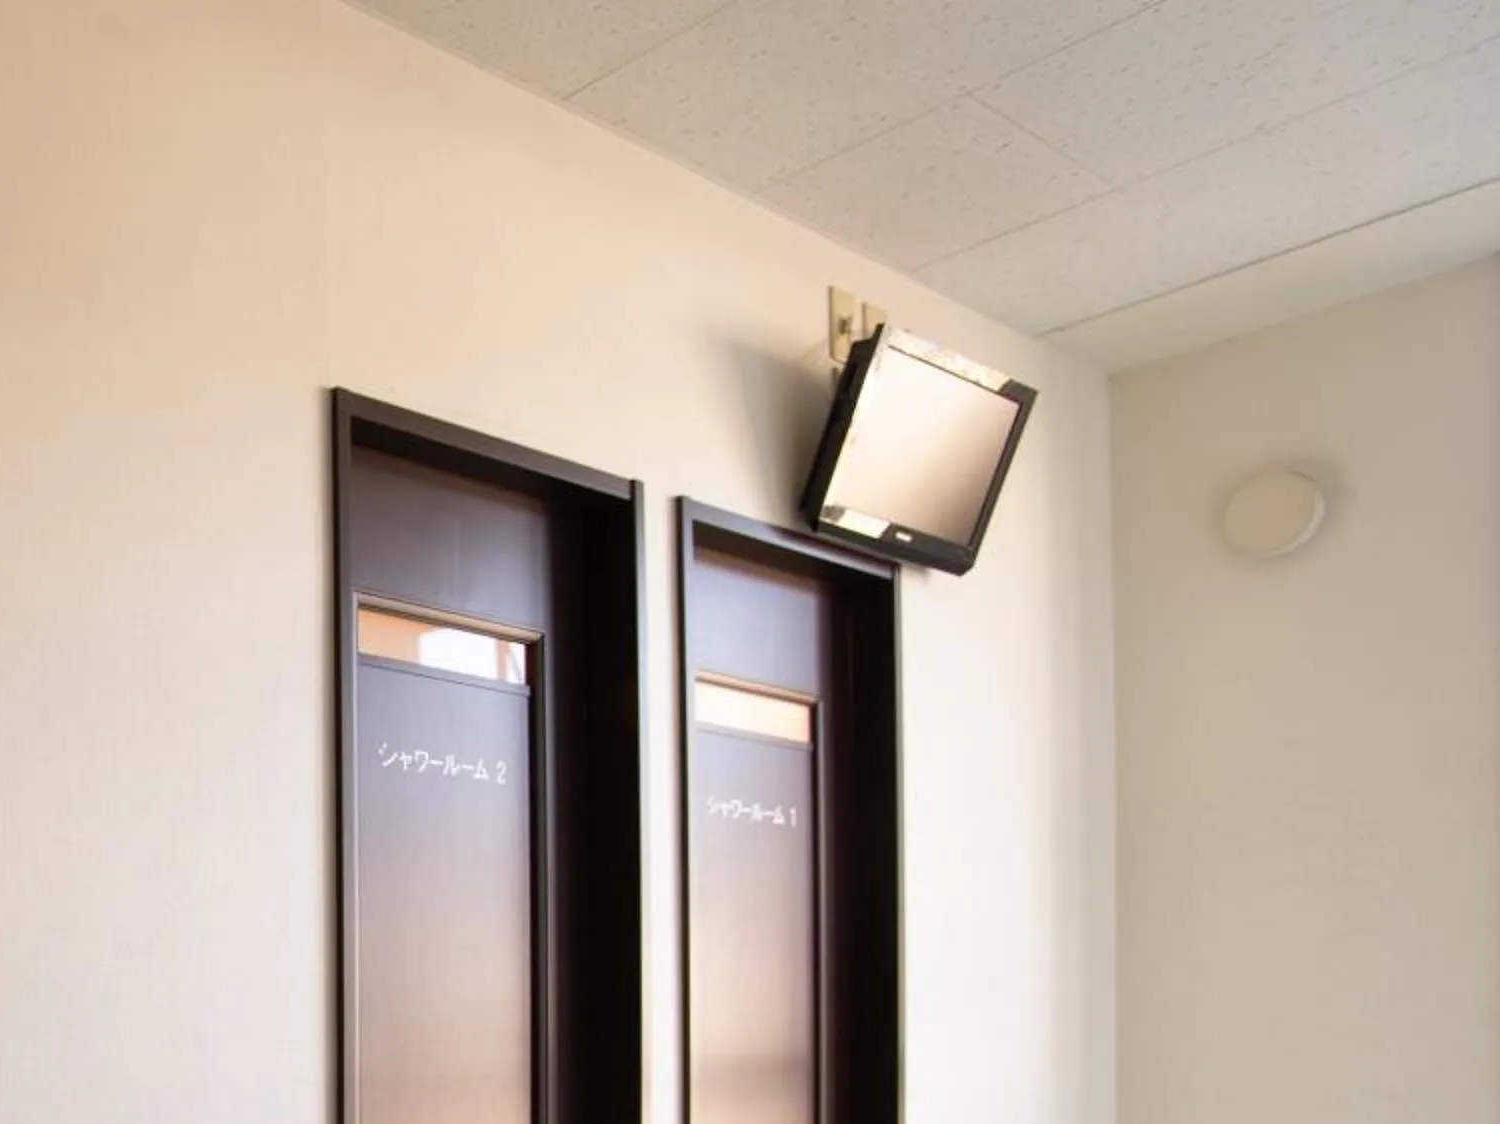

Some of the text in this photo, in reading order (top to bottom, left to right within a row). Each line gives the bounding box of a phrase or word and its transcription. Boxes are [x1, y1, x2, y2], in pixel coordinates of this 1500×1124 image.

[378, 741, 507, 785] シャワールーム 2
